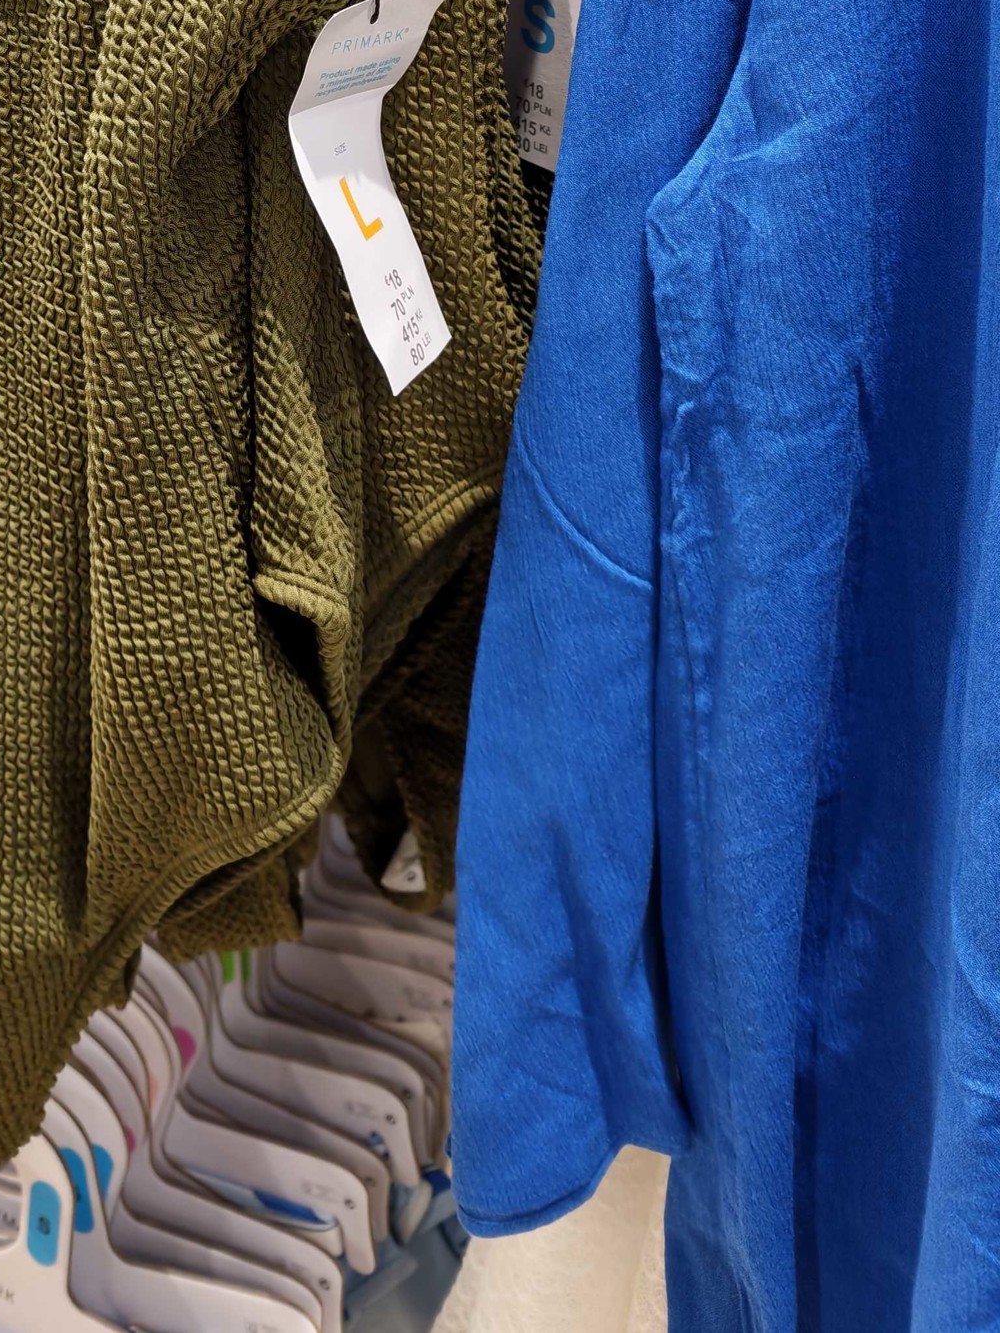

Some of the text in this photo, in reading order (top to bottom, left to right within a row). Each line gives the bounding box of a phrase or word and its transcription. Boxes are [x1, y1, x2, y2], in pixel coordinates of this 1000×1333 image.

[319, 56, 401, 81] Product made using
[533, 102, 552, 116] PLN
[334, 142, 347, 156] SIZE
[533, 140, 548, 155] LEI
[339, 176, 384, 241] L
[384, 269, 402, 290] €18
[390, 284, 415, 321] 70 PLN
[402, 316, 419, 343] 415
[410, 331, 432, 366] 80 LEI
